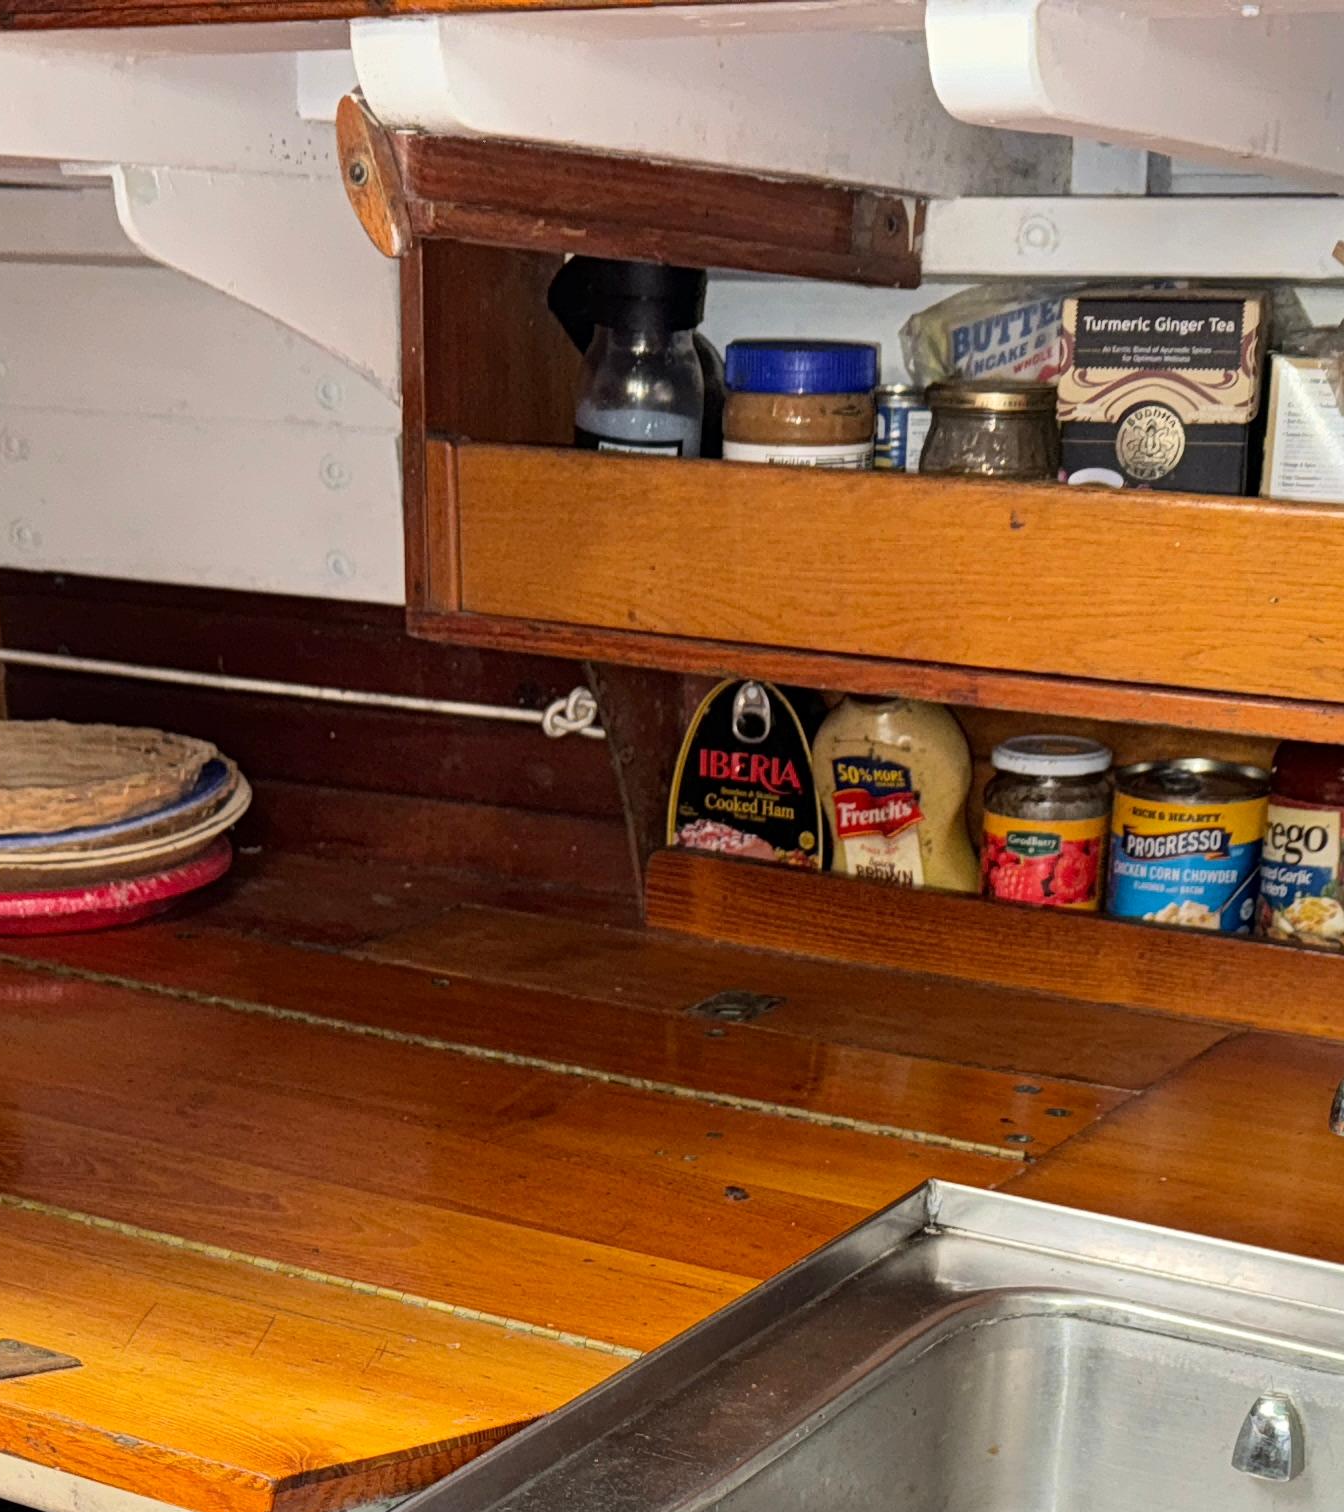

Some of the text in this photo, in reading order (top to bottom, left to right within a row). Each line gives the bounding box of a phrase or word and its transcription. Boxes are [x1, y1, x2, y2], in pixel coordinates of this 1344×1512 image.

[952, 301, 1061, 362] BUTTE
[1083, 316, 1236, 336] Turmeric Ginger Tea
[974, 341, 1029, 375] NCAKE
[1126, 409, 1176, 428] BUDDHA
[699, 748, 802, 795] IBERIA
[837, 763, 873, 785] 50%
[704, 793, 758, 814] Cooked
[761, 800, 795, 820] Ham
[837, 798, 914, 828] French's
[1131, 806, 1157, 820] RICH
[1168, 812, 1222, 823] HEARTY
[1127, 829, 1222, 858] PROGRESSO
[1114, 859, 1238, 884] CHICKEN CORN CHOWDER
[1278, 867, 1313, 886] Garlic
